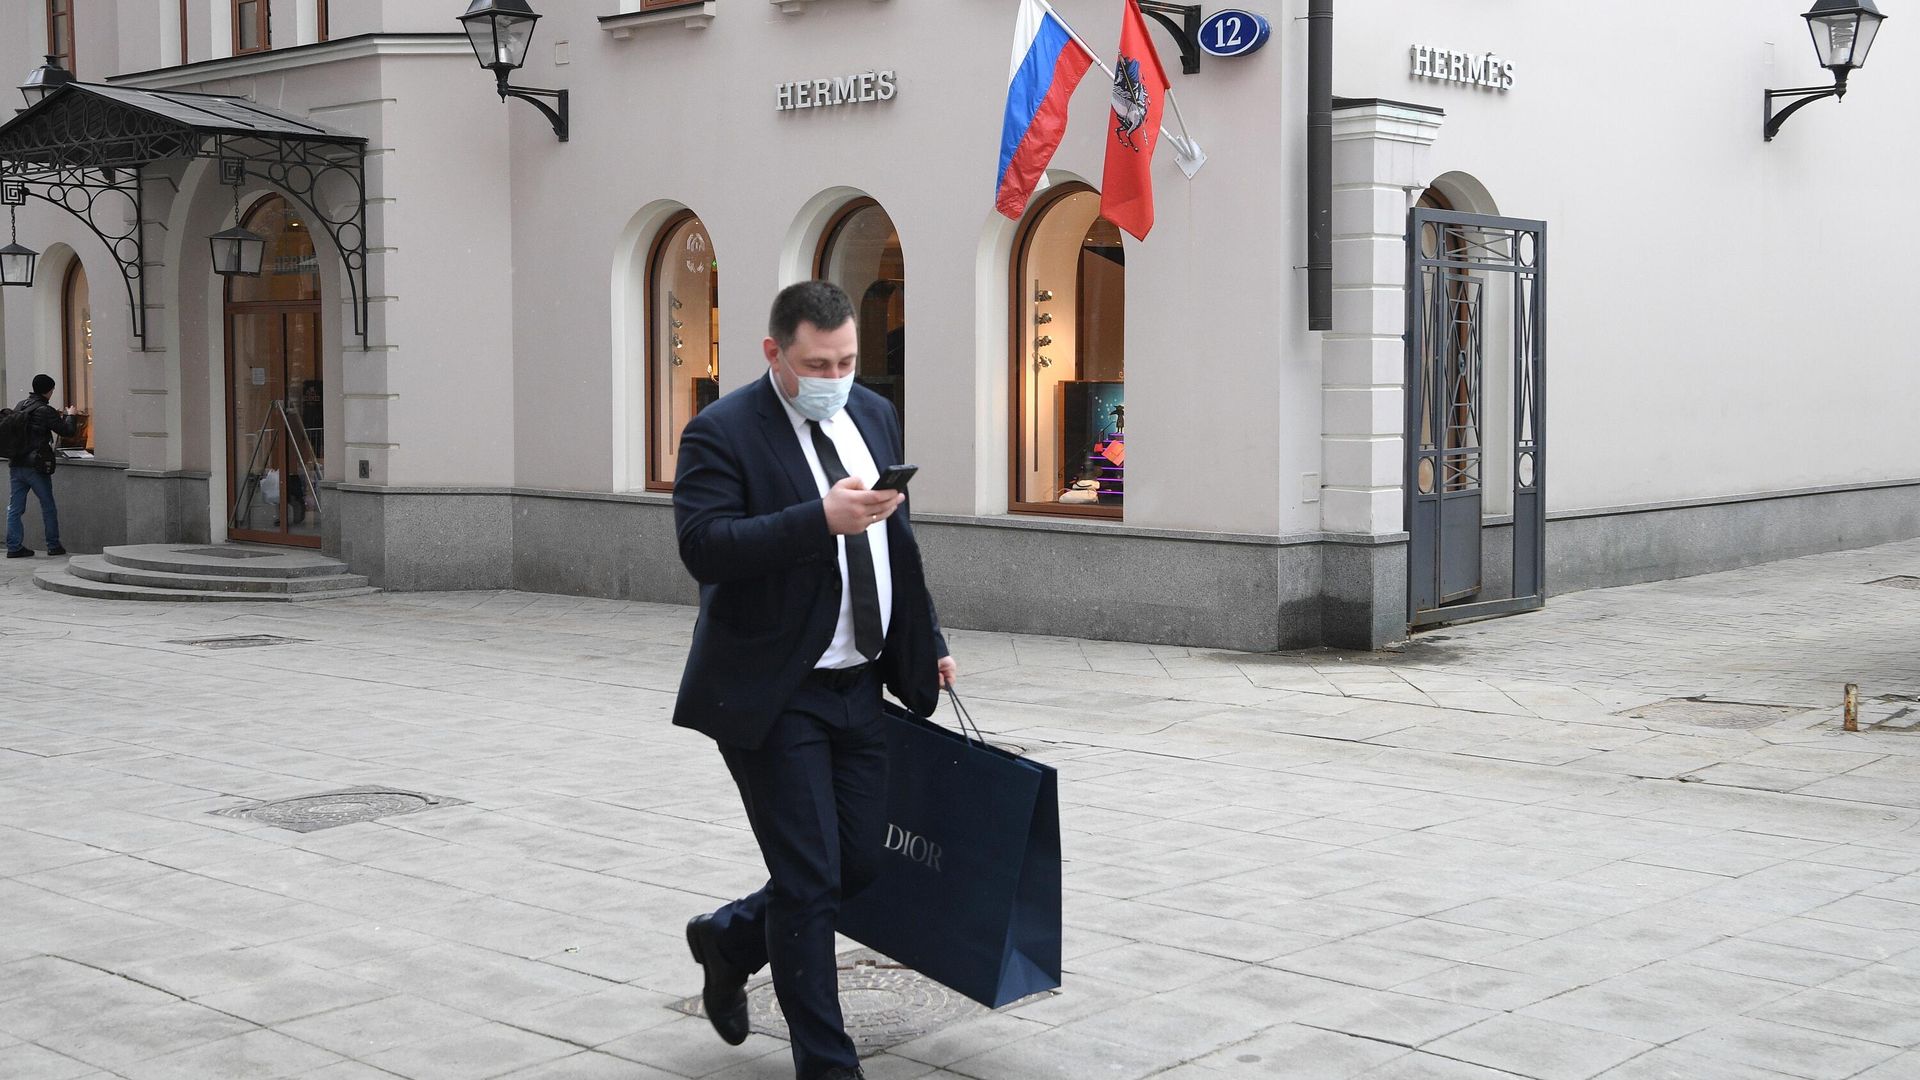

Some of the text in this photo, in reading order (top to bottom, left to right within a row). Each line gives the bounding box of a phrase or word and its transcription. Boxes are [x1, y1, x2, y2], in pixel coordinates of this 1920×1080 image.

[1215, 17, 1242, 48] 12
[775, 69, 897, 111] HERMÈS
[884, 822, 942, 873] DIOR
